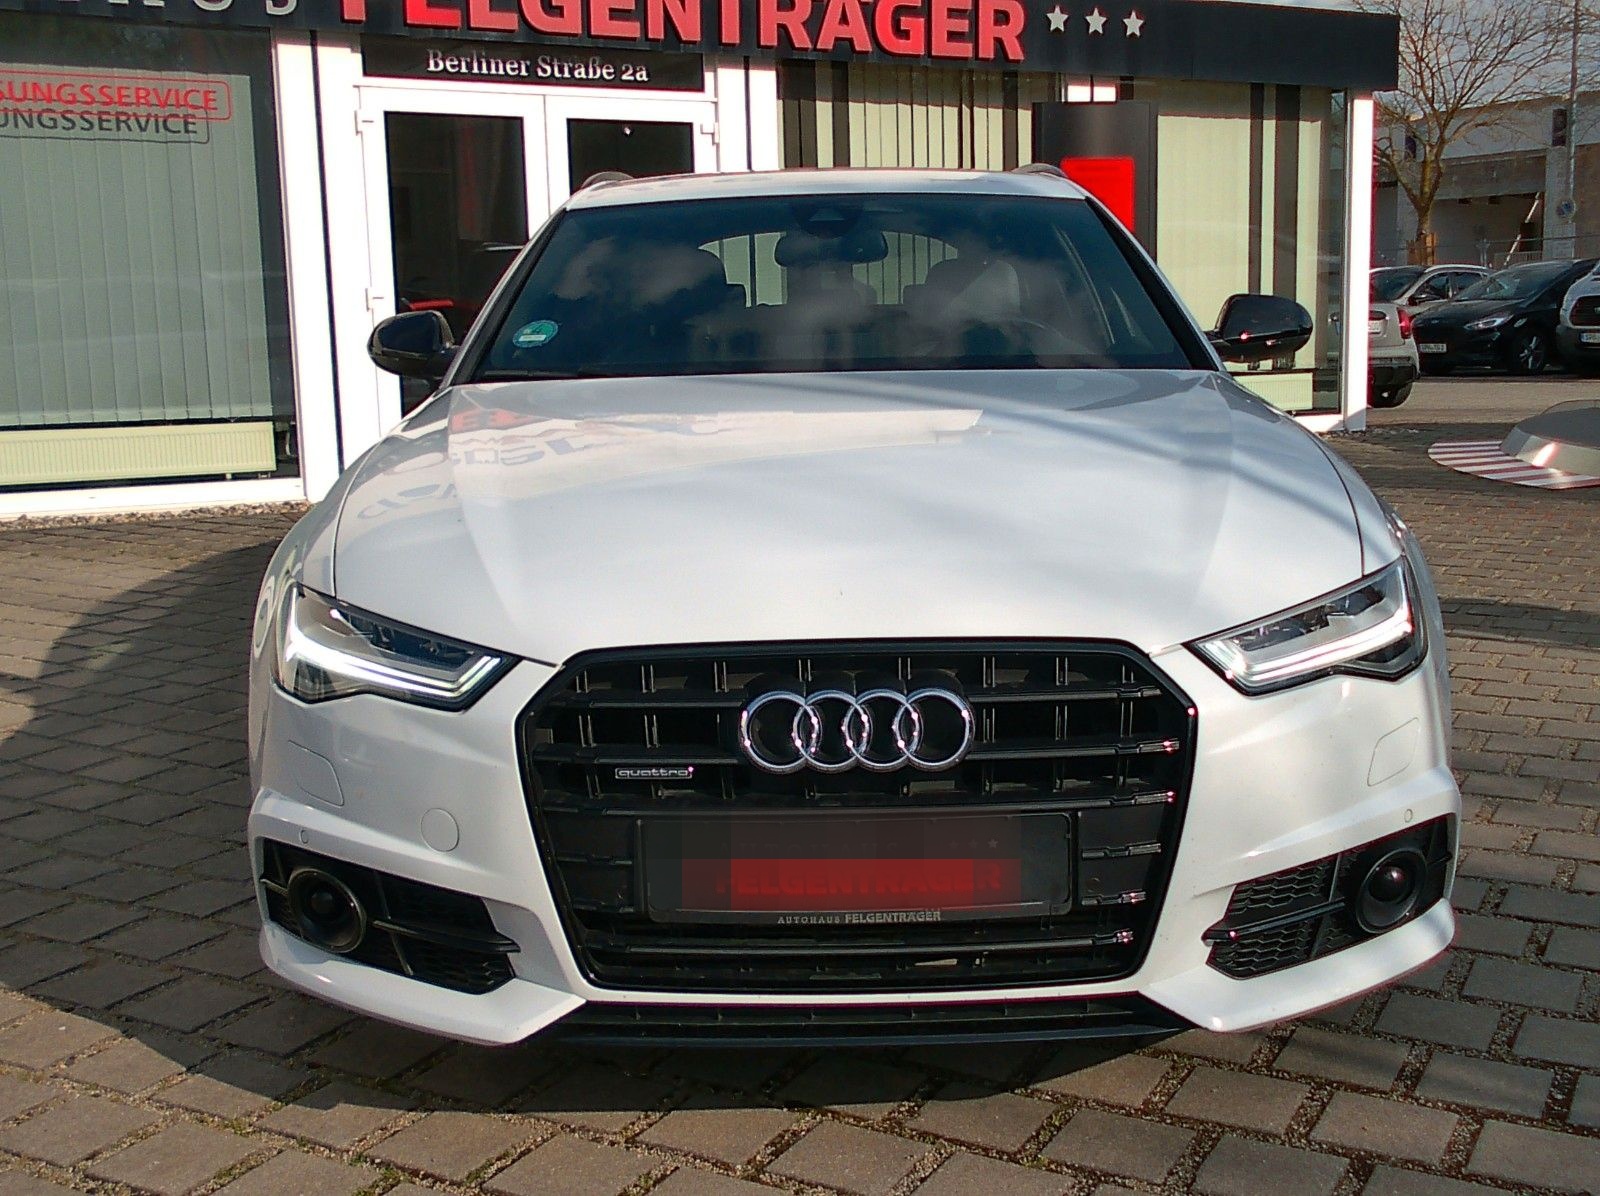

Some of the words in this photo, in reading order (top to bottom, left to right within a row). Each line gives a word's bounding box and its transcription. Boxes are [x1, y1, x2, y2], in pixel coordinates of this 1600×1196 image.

[342, 0, 1025, 60] GENTRÄGER
[427, 49, 530, 77] Berliner
[536, 55, 615, 80] Straße
[620, 63, 648, 82] 2a
[619, 768, 688, 779] quattro
[777, 915, 841, 925] AUTOHAUS
[844, 911, 941, 924] FELGENTRÄGER
